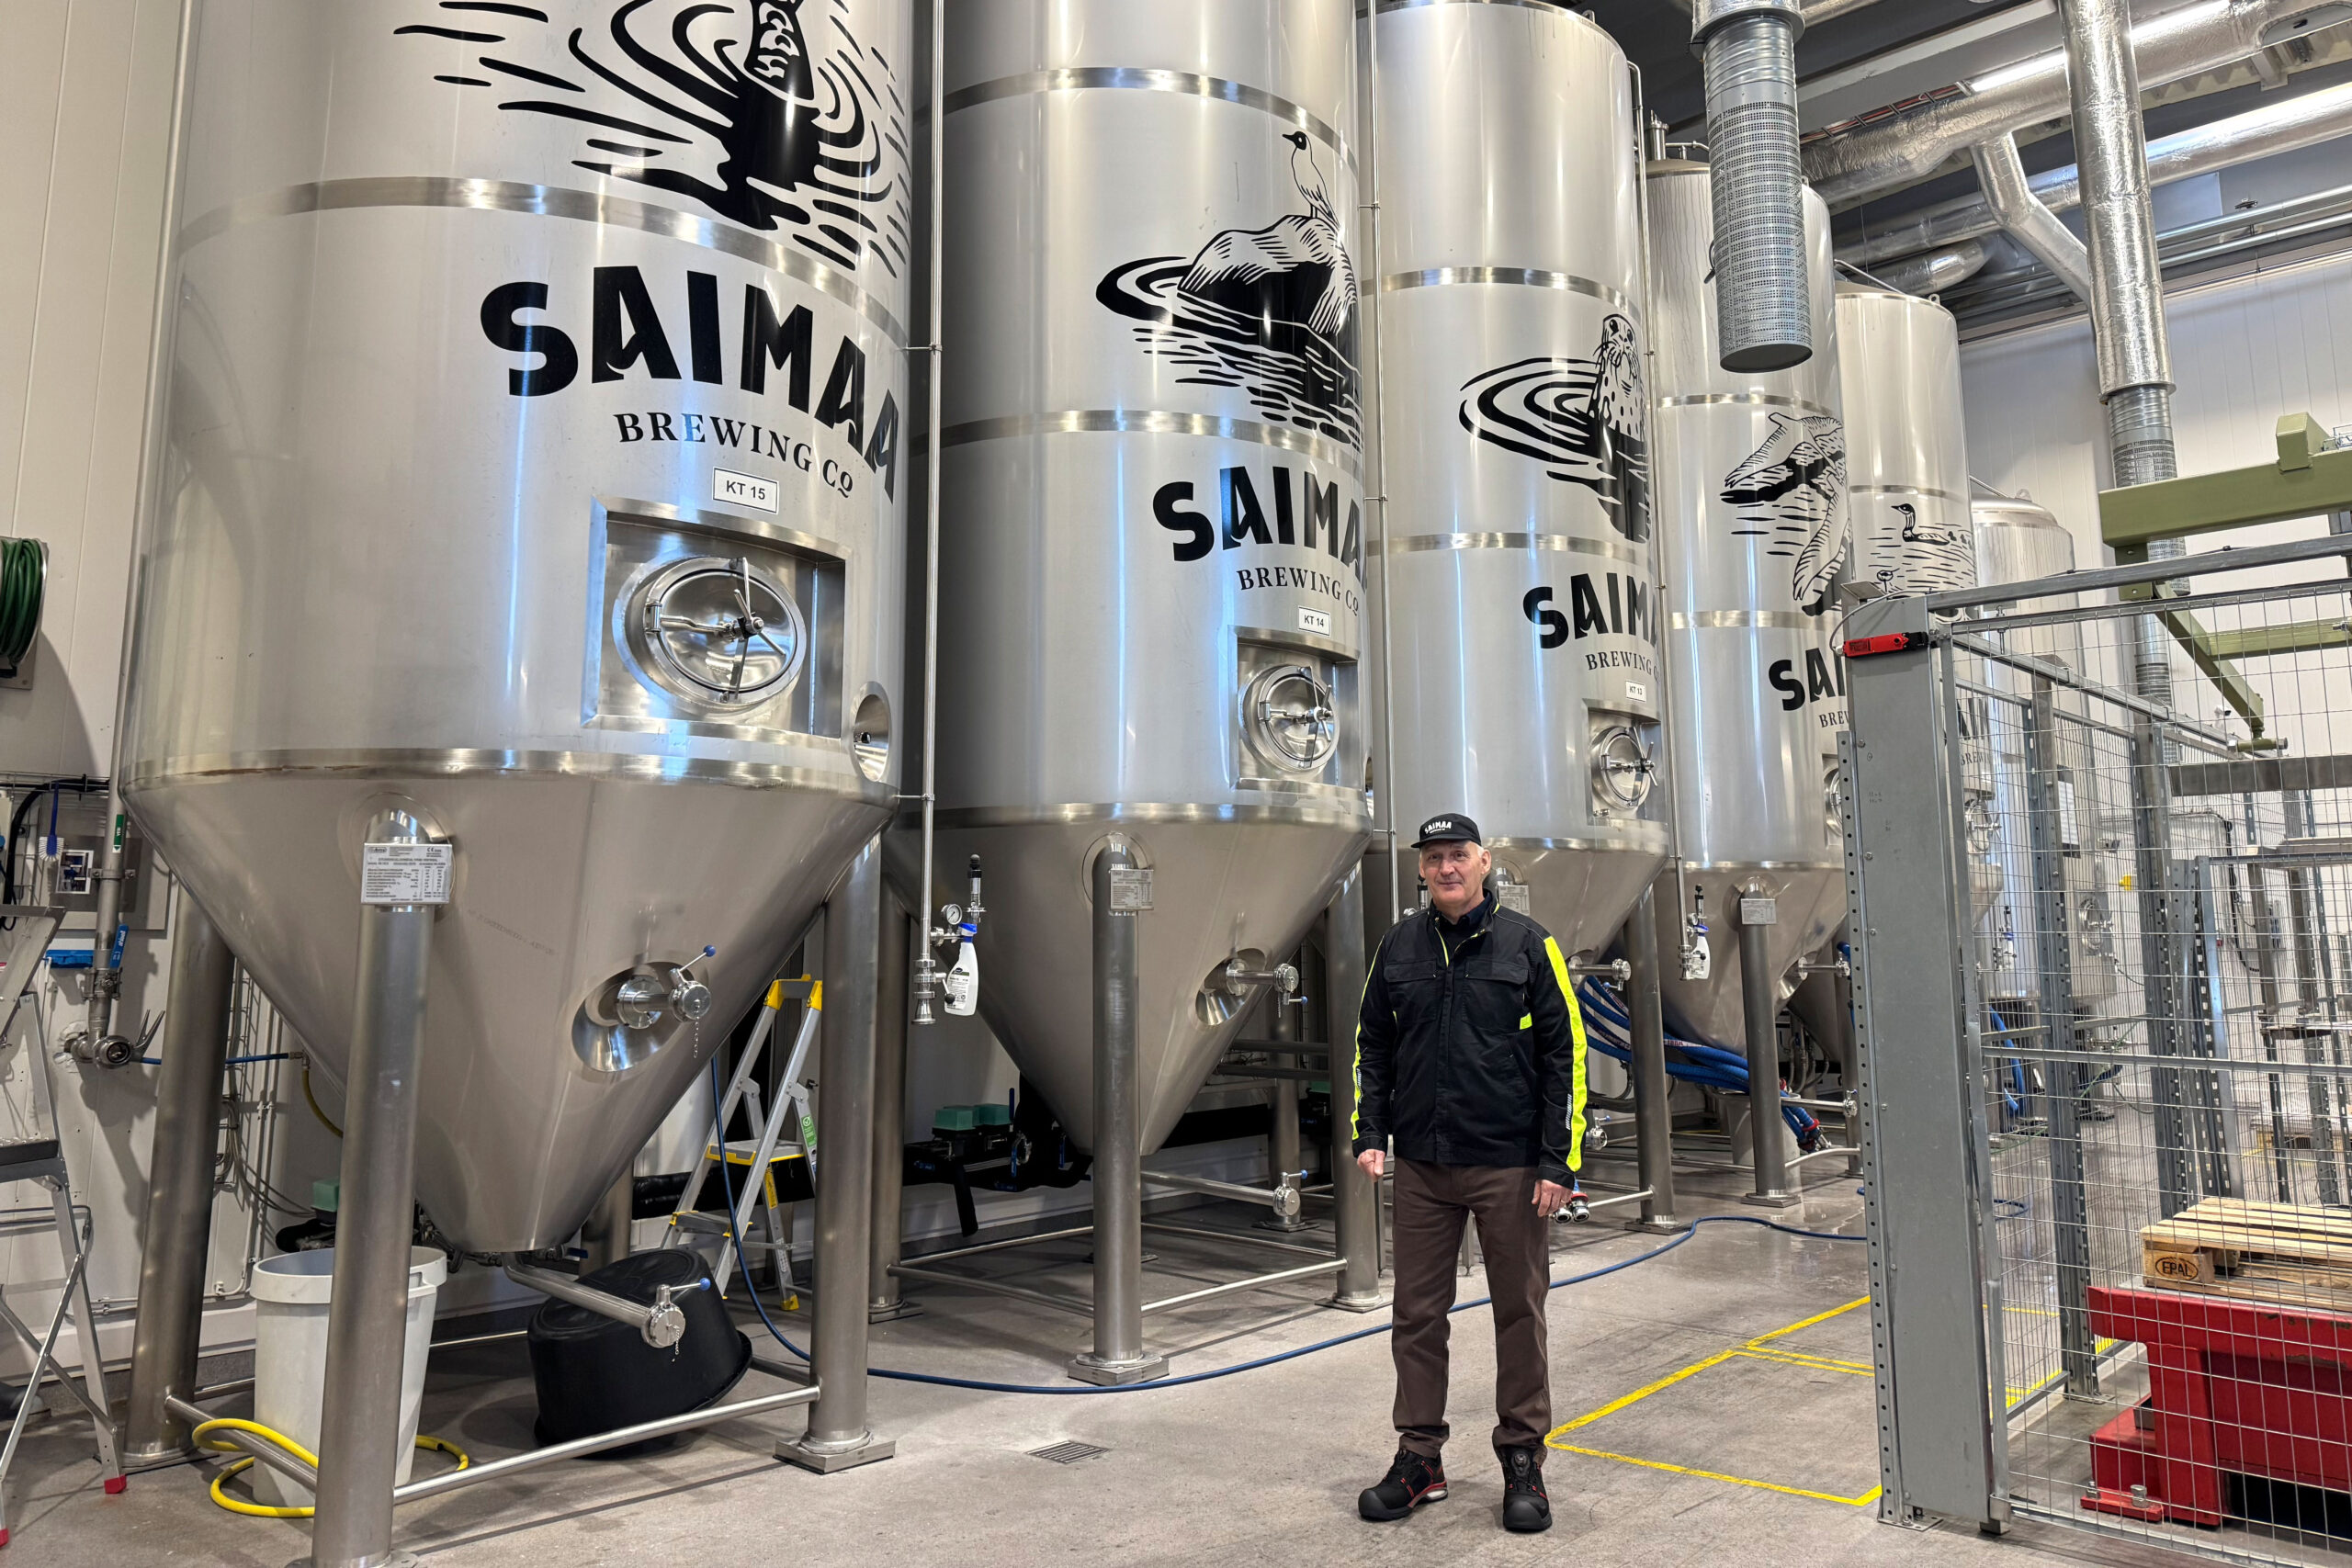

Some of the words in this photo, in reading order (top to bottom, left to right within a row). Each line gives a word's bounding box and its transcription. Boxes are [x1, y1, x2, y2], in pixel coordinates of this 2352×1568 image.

[480, 265, 899, 505] SAIMAA
[614, 412, 812, 472] BREWING
[726, 479, 747, 496] KT
[750, 486, 765, 501] 15
[1237, 566, 1341, 601] BREWING
[1304, 615, 1315, 625] KT
[1317, 617, 1324, 627] 14
[1585, 650, 1652, 676] BREWING
[1768, 647, 1847, 711] SAI
[2162, 1261, 2193, 1277] EPAL
